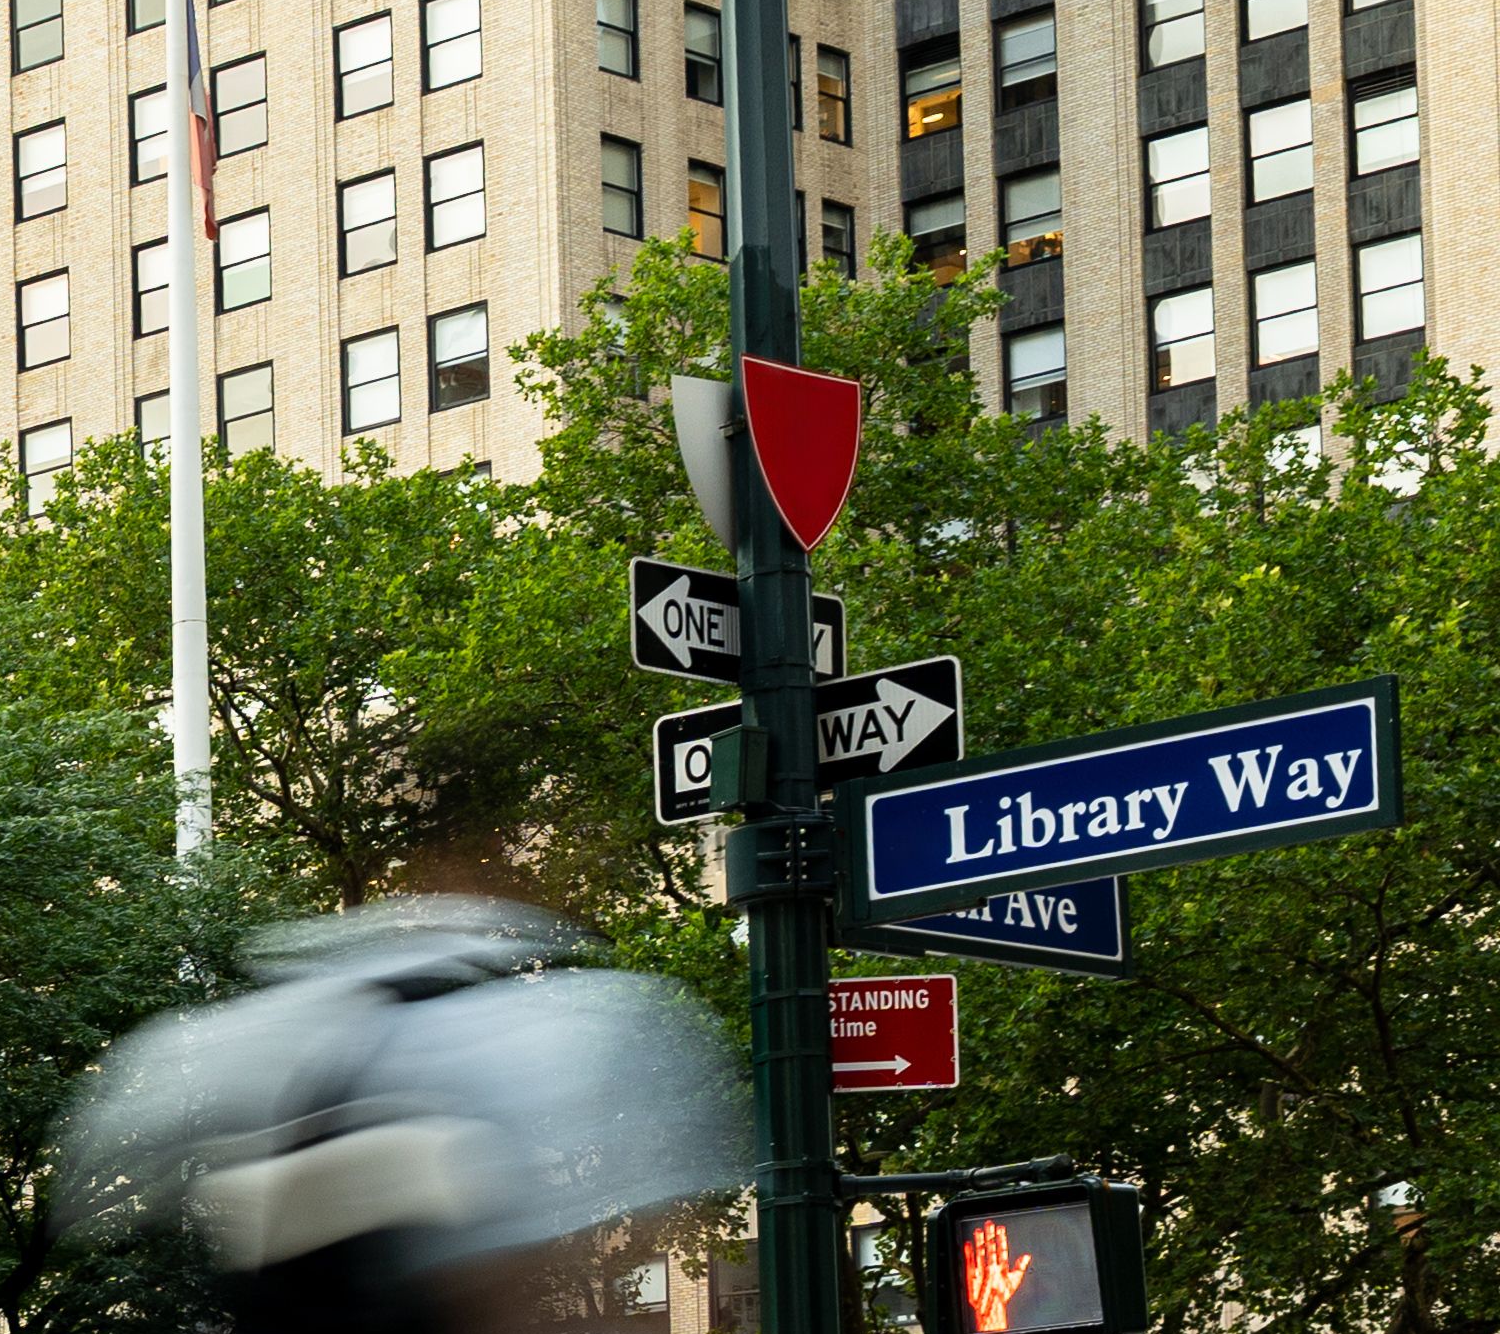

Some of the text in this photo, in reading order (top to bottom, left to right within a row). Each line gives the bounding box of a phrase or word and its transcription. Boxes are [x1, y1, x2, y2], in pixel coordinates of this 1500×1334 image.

[663, 598, 726, 649] ONE
[819, 698, 917, 758] WAY
[943, 743, 1364, 865] Library Way
[1003, 890, 1079, 935] Ave
[830, 1017, 878, 1038] time
